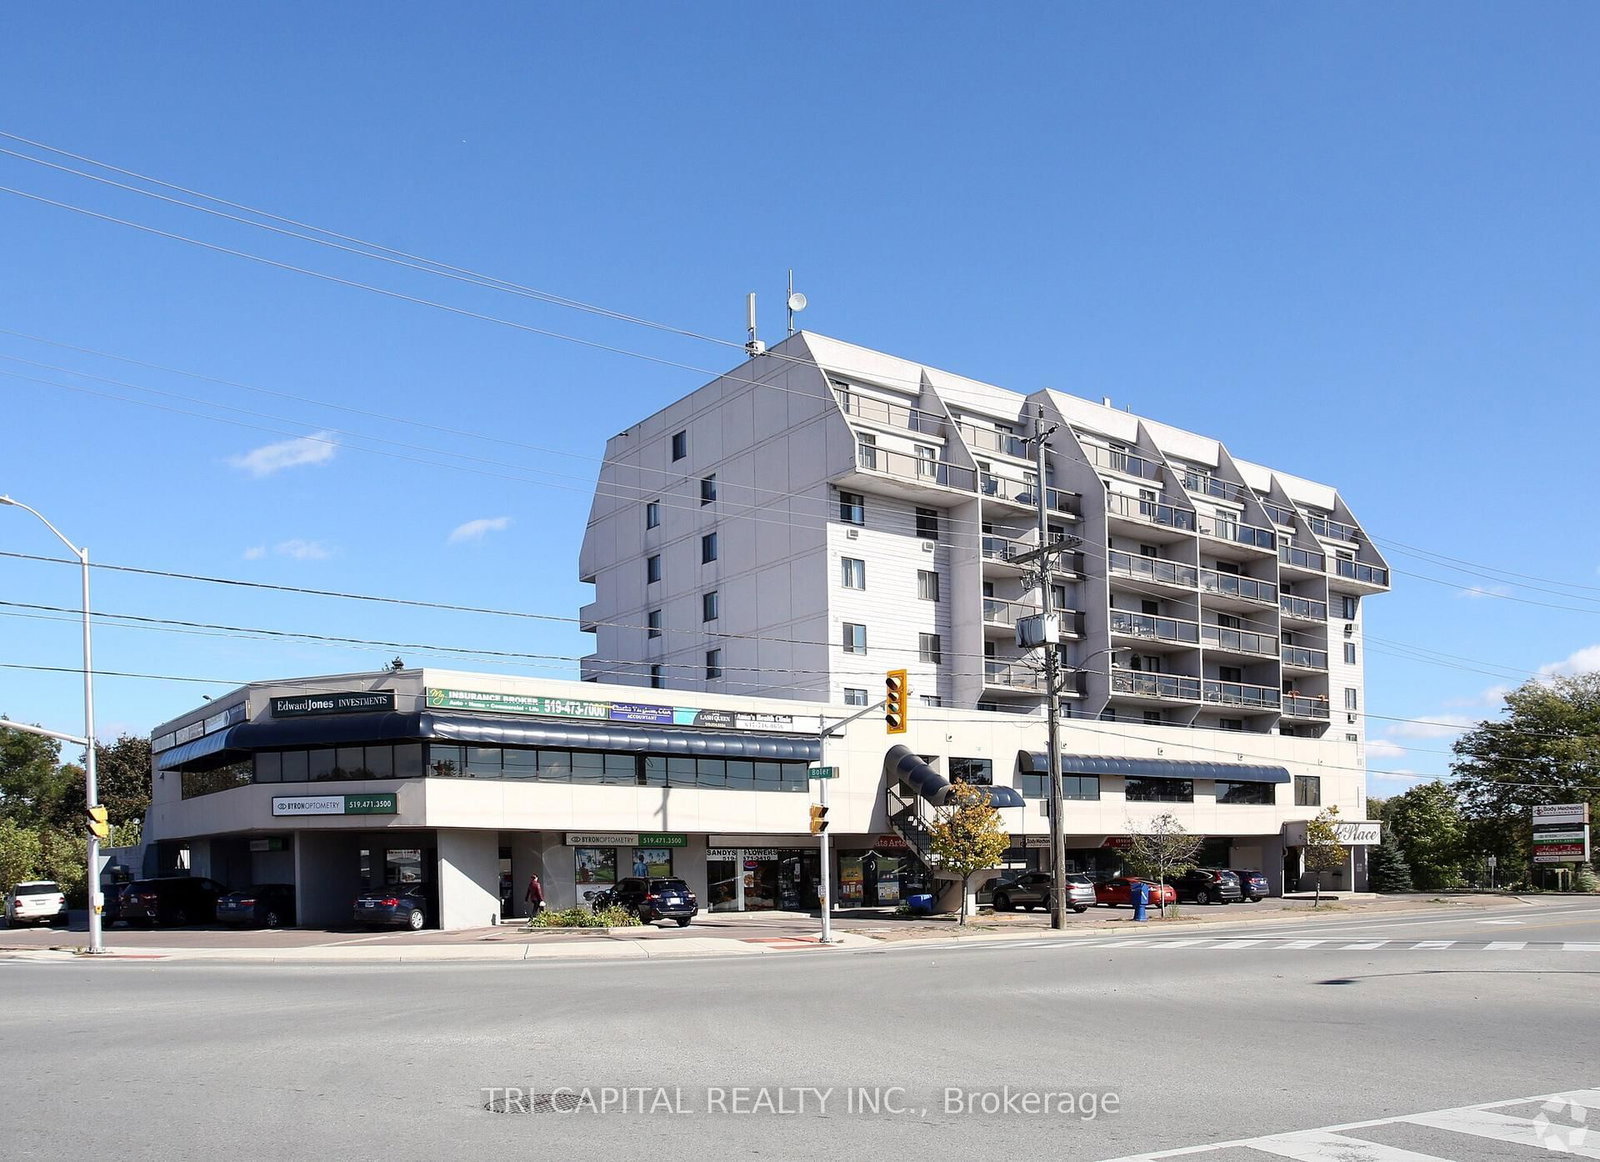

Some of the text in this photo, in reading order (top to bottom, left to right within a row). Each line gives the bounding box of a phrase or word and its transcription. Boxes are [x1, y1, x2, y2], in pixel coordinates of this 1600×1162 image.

[338, 695, 388, 708] INVESTMENTS
[449, 691, 502, 702] INSURANCE
[503, 695, 539, 705] BROKER
[544, 699, 606, 717] 519-473-7000
[626, 713, 658, 721] ACCOUNTANT
[775, 716, 792, 724] Clinic
[349, 800, 392, 809] 519.471.3500
